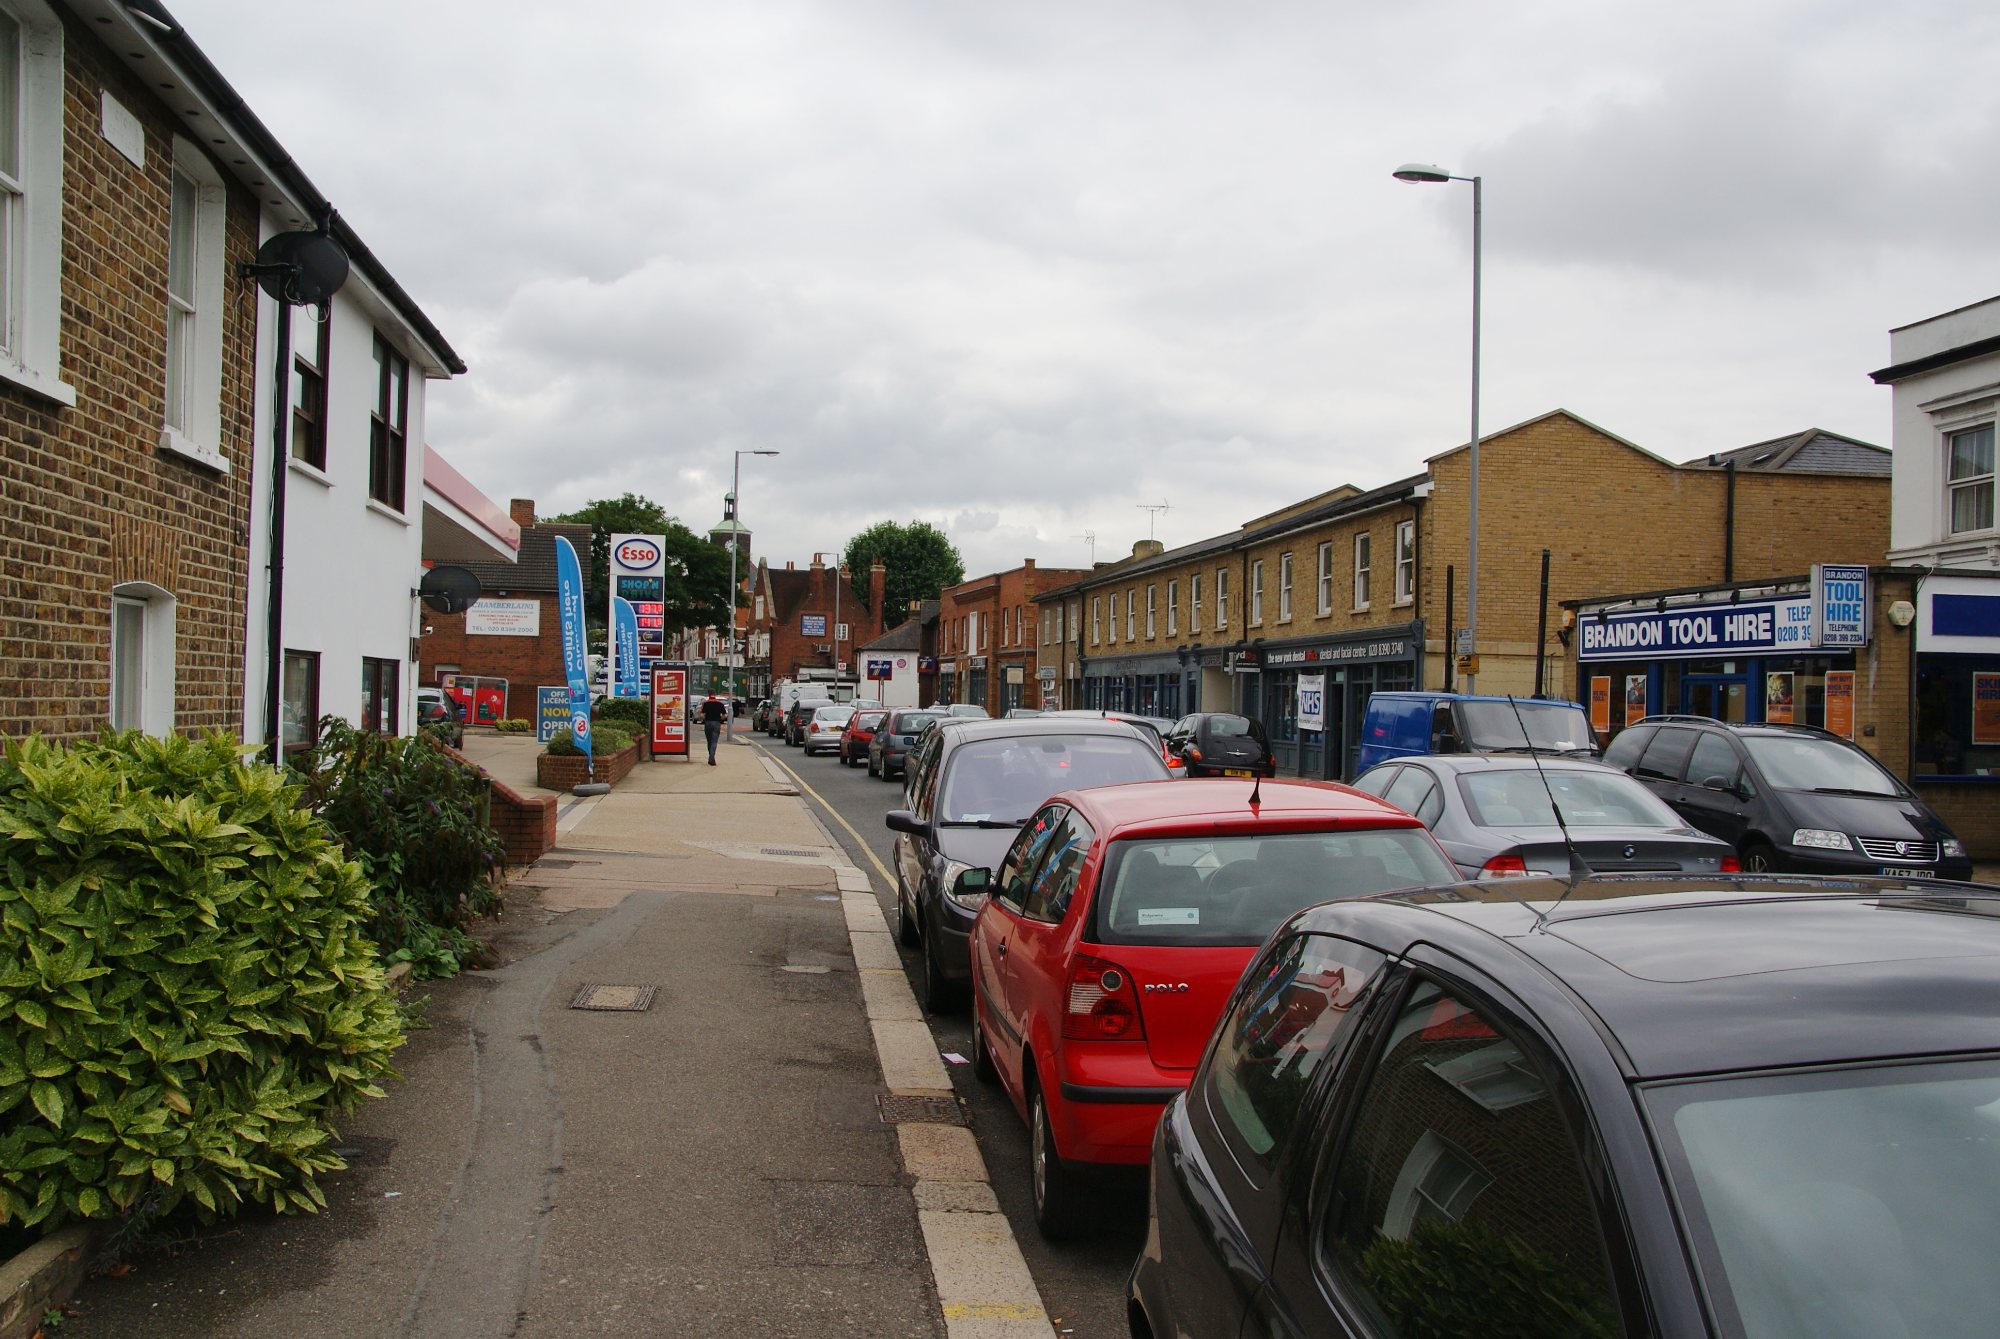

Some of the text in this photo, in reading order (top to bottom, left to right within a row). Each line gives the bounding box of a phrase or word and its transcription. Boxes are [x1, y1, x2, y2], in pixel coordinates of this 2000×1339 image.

[1825, 571, 1862, 580] BRANDON
[1825, 582, 1863, 602] TOOL
[1787, 605, 1811, 623] TELEP
[1826, 603, 1862, 622] HIRE
[1584, 612, 1772, 649] BRANDON TOOL HIRE
[1777, 626, 1799, 643] 0208
[1828, 624, 1859, 632] TELEPHONE
[1824, 633, 1837, 642] 0208
[1267, 652, 1275, 664] the
[1292, 650, 1306, 662] dental
[1320, 647, 1332, 660] dental
[1333, 647, 1341, 659] and
[1353, 646, 1367, 658] centre
[1369, 644, 1378, 657] 020
[1301, 691, 1321, 715] NHS
[543, 708, 571, 717] NOW
[543, 721, 573, 730] OPEN
[1144, 982, 1189, 993] POLO
